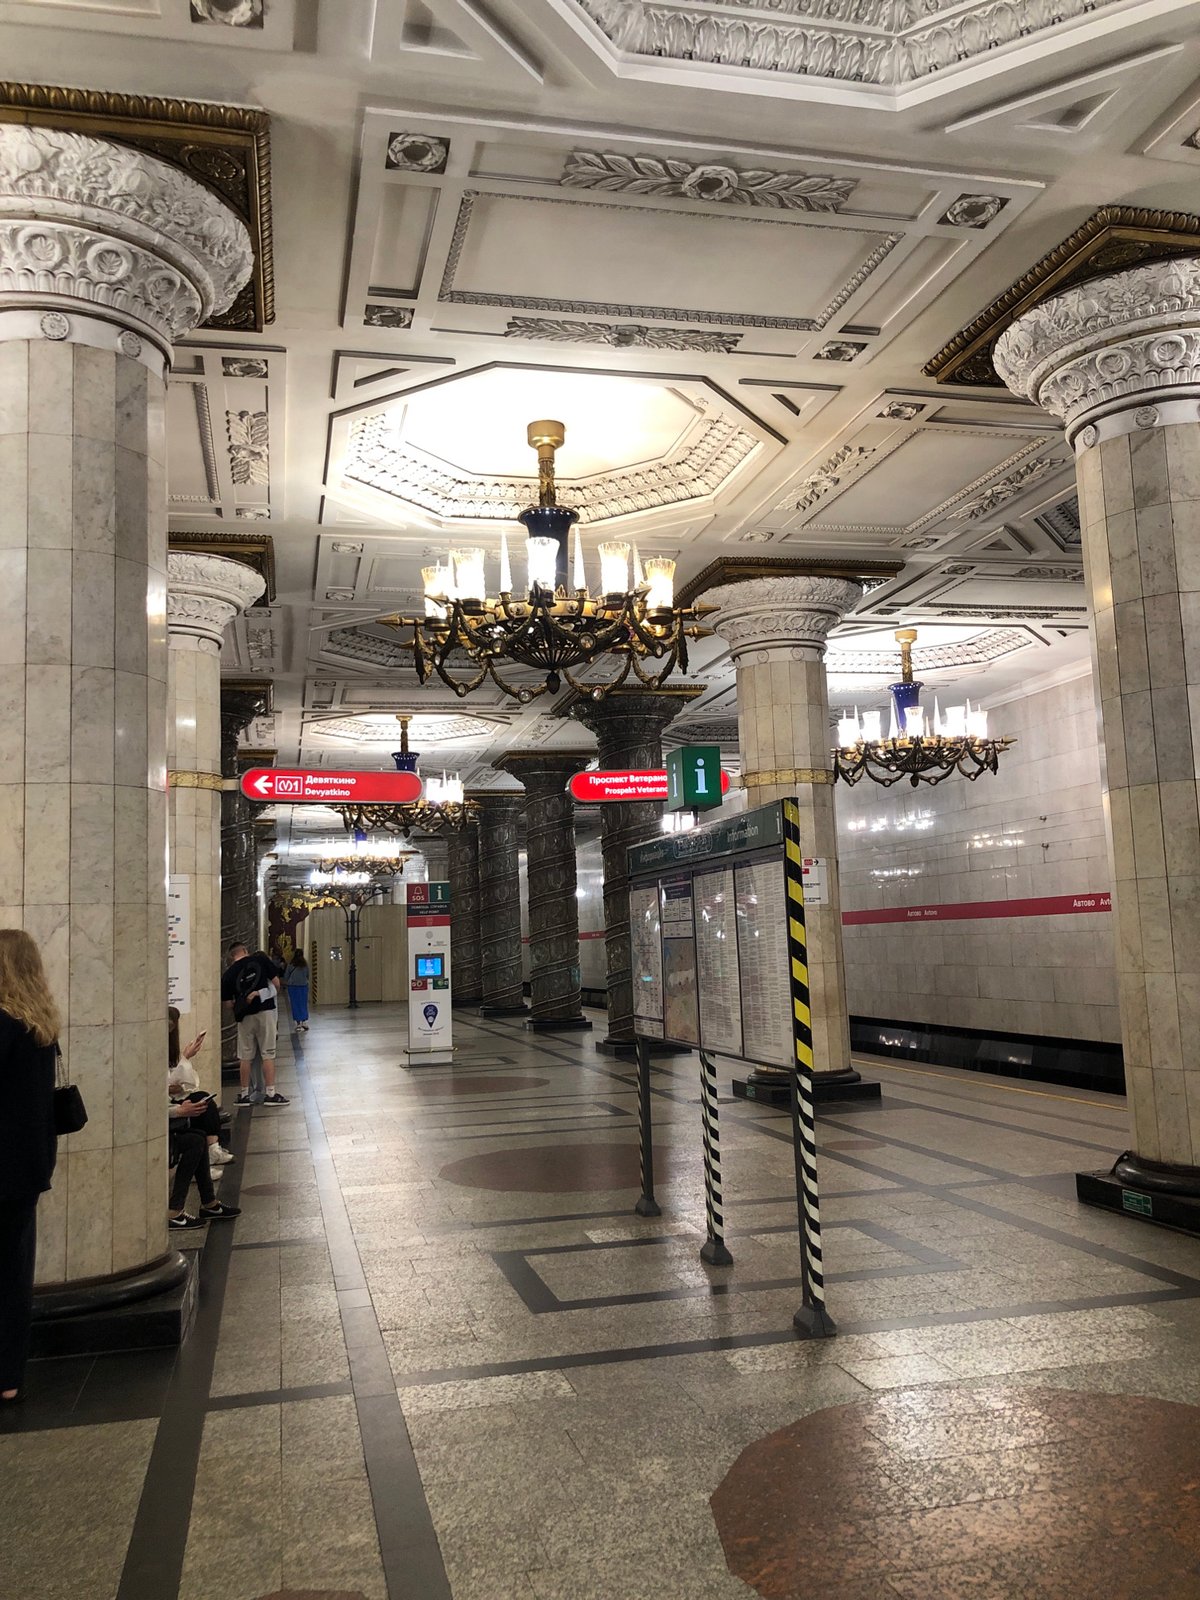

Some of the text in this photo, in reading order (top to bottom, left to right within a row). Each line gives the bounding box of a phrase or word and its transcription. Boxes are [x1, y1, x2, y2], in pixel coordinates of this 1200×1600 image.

[305, 775, 357, 785] Девяткино
[589, 775, 668, 786] Проспект Ветерано
[305, 788, 350, 797] Devyatkino
[605, 787, 636, 795] Prospekt
[1073, 899, 1096, 907] Автово
